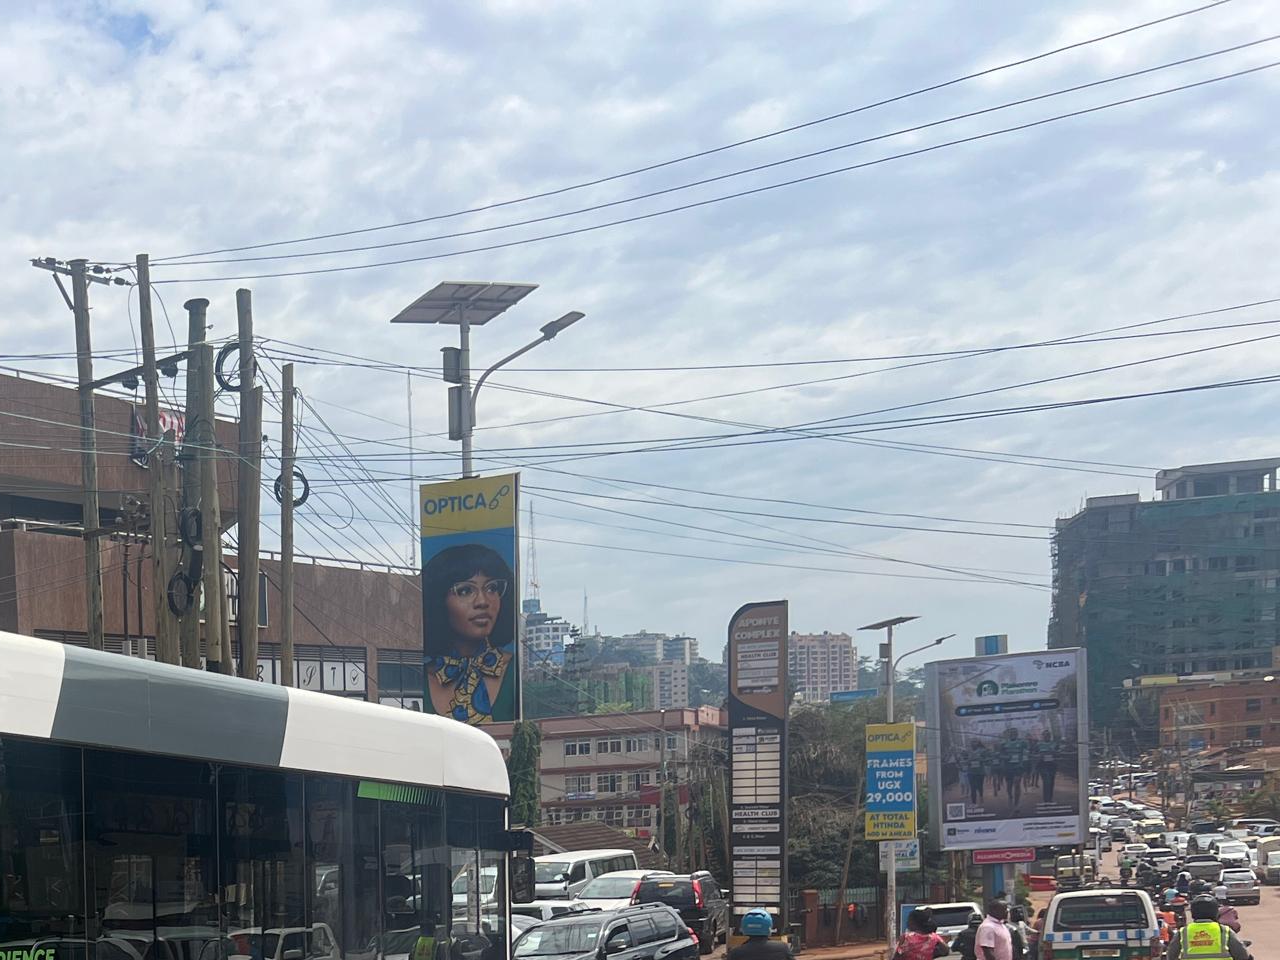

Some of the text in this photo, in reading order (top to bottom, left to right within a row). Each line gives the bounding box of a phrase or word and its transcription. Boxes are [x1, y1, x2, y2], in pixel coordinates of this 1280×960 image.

[424, 492, 487, 516] OPTICA
[735, 629, 780, 640] COMPLEX
[867, 733, 899, 743] OPTICA
[867, 758, 913, 769] FRAMES
[876, 771, 904, 779] FROM
[878, 782, 901, 790] UGX
[866, 792, 913, 804] 29,000
[883, 813, 910, 821] TOTAL
